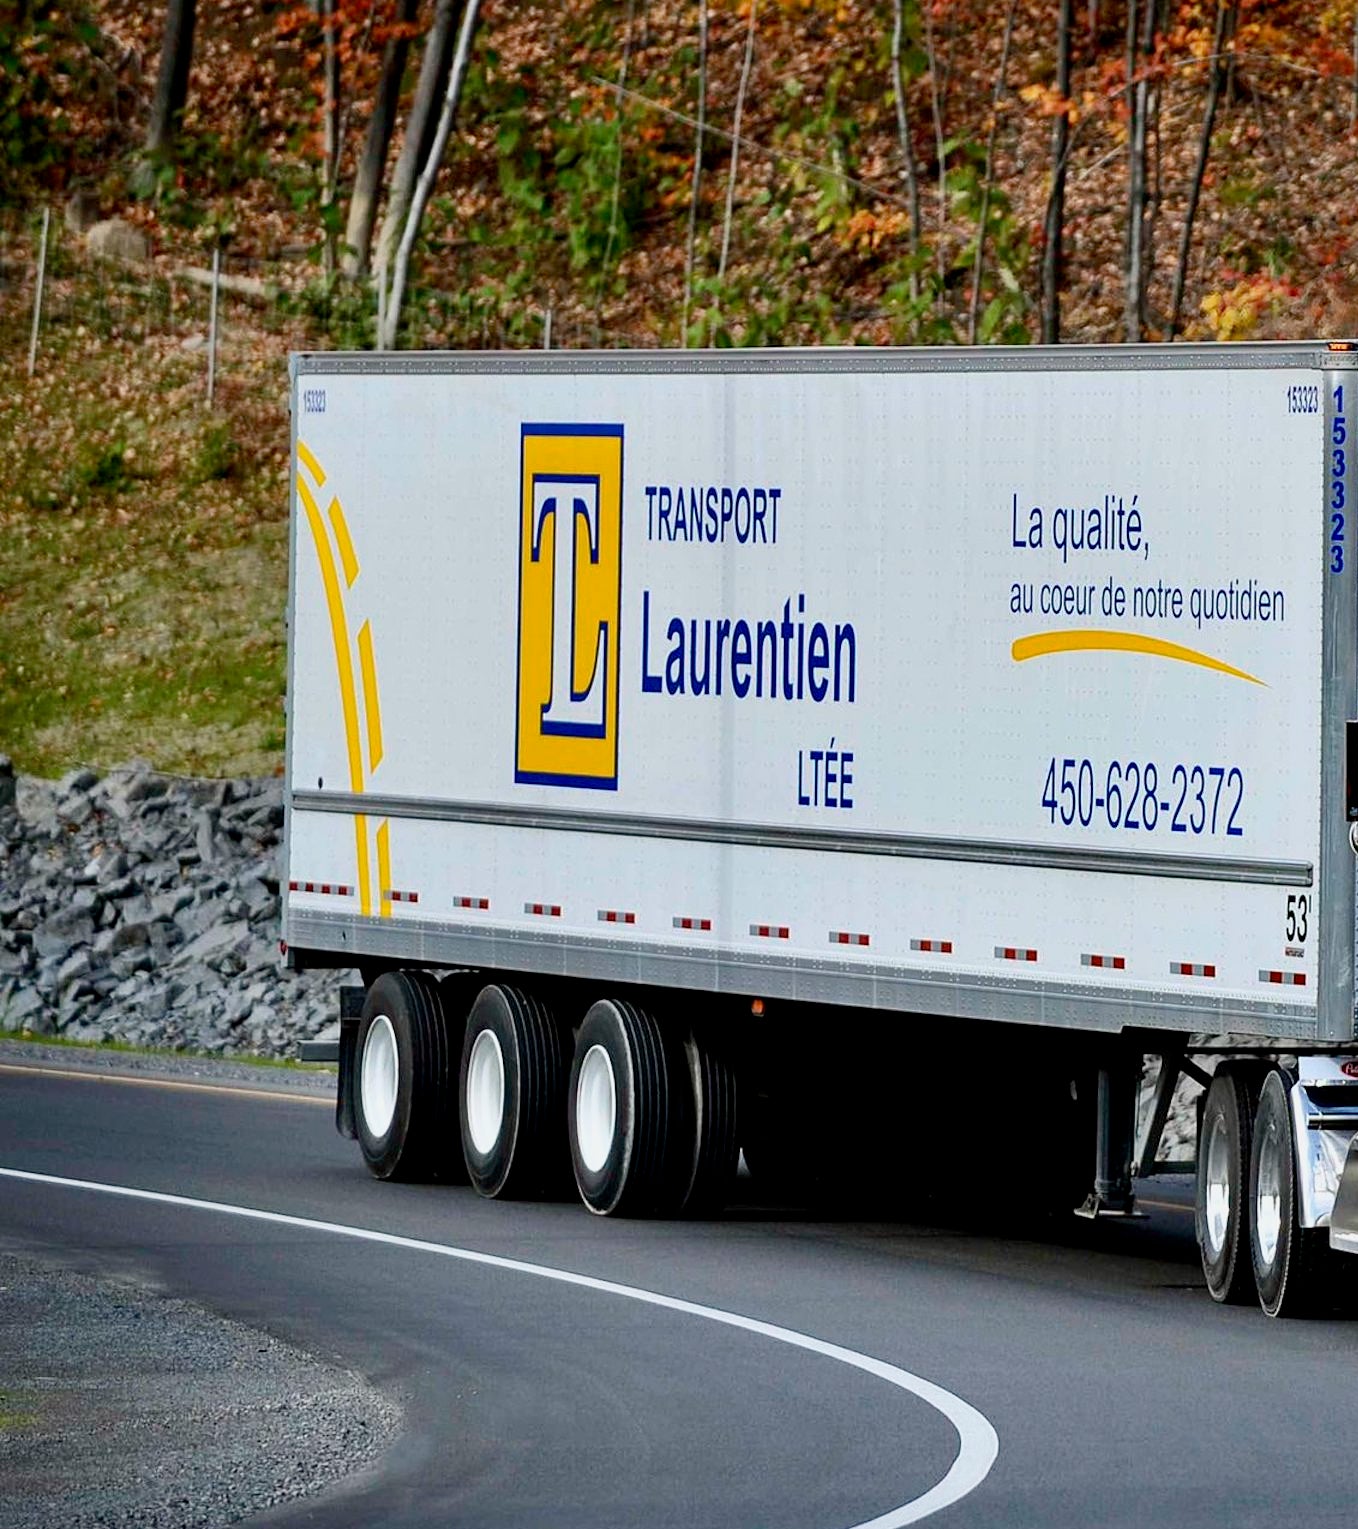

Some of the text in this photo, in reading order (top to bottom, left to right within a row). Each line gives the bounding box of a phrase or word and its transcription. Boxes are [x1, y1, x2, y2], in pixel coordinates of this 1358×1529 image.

[1288, 386, 1318, 413] 153323
[1331, 386, 1345, 573] 153323
[646, 487, 781, 543] TRANSPORT
[1013, 494, 1148, 563] La qualité,
[1011, 577, 1284, 629] au coeur de notre quotidien
[642, 591, 855, 702] Laurentien
[799, 737, 853, 808] LTÉE
[1042, 758, 1243, 835] 450-628-2372
